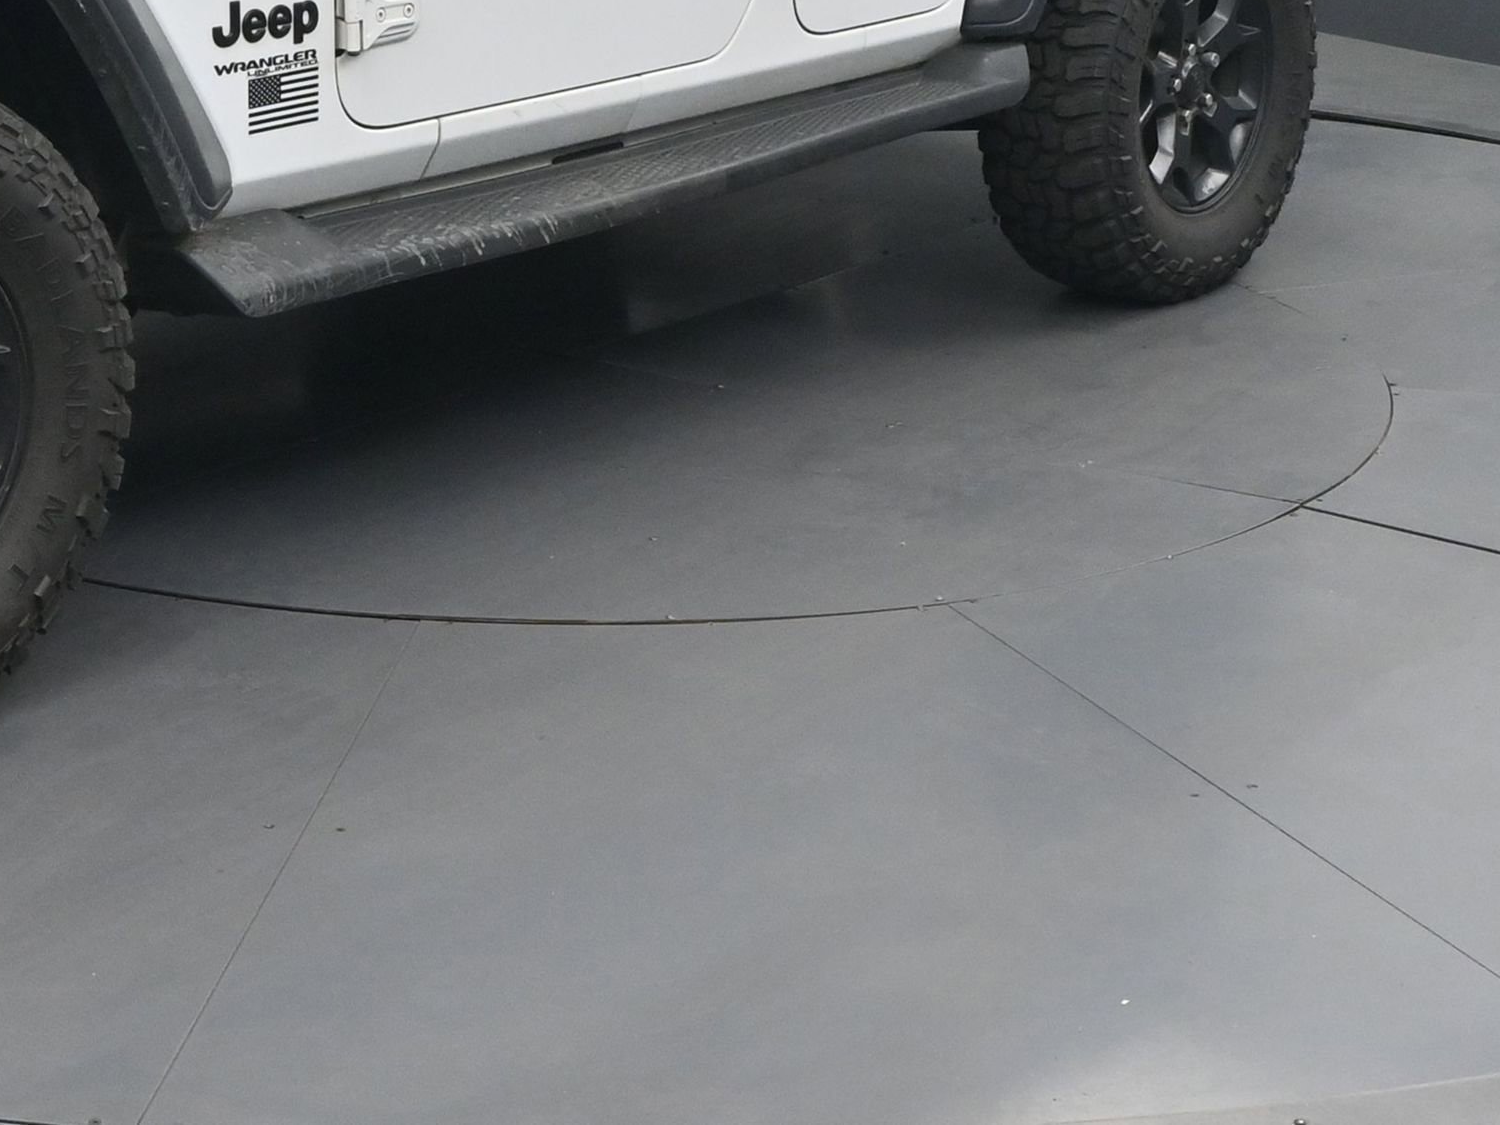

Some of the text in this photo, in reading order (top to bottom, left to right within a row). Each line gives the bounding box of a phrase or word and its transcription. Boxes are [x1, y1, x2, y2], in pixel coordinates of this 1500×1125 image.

[211, 0, 320, 49] Jeep
[213, 48, 318, 77] WRANGLER
[247, 59, 318, 77] UNLIMITED
